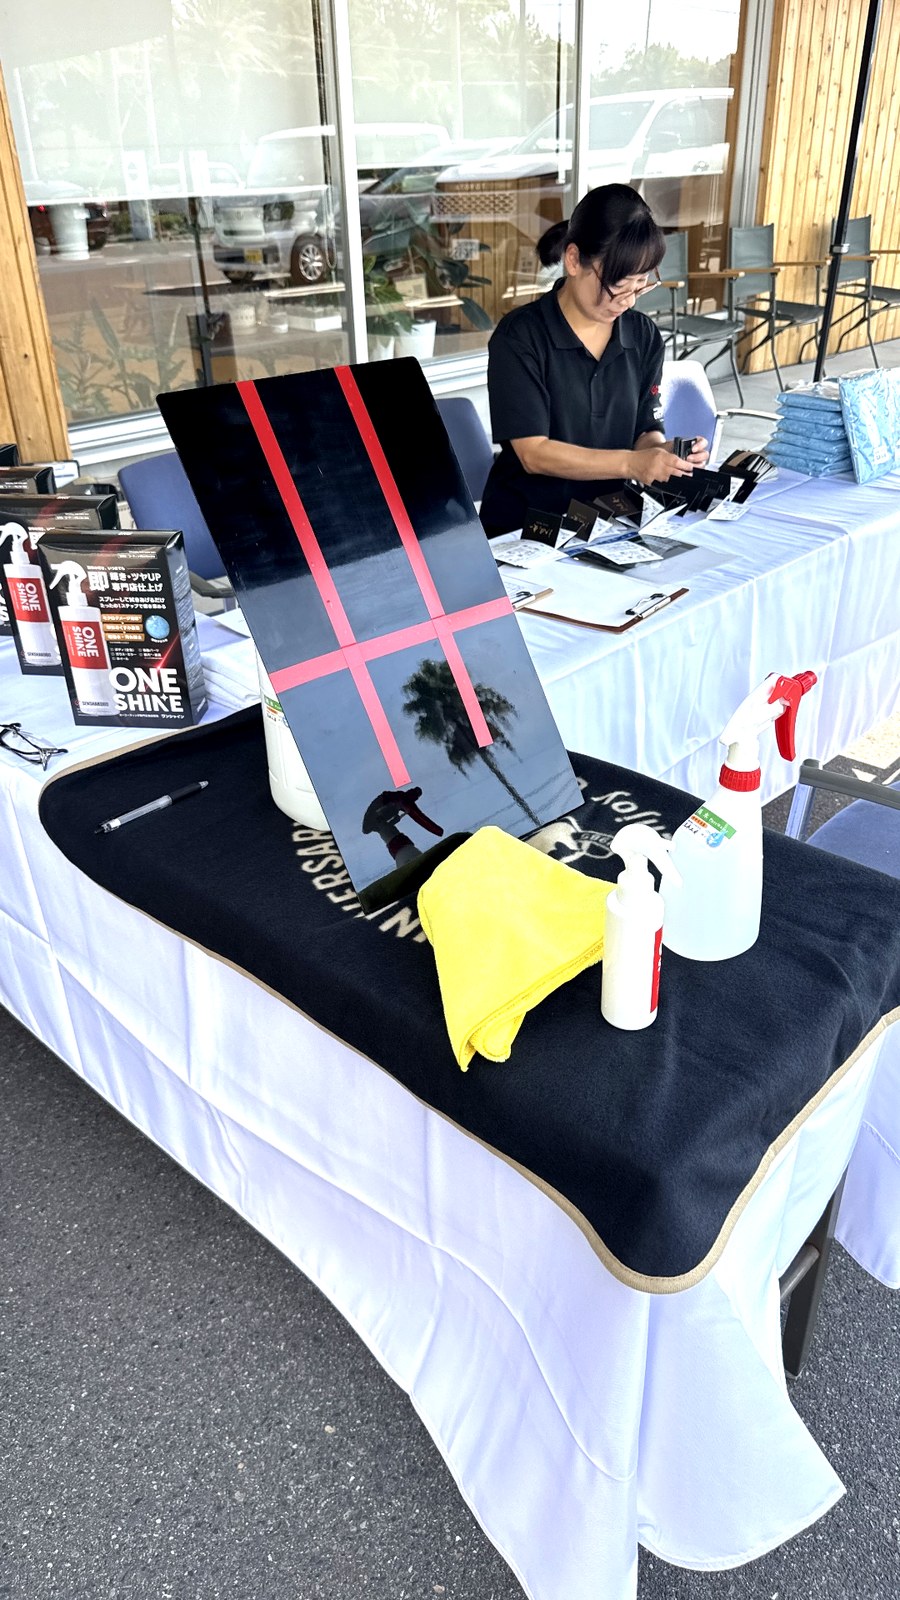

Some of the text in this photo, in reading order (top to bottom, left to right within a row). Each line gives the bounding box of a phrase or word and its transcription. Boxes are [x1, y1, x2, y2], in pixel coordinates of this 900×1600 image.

[25, 582, 41, 612] ONE
[72, 626, 87, 657] SHINE
[82, 626, 99, 658] ONE
[109, 667, 180, 692] ONE
[114, 693, 183, 712] SHINE
